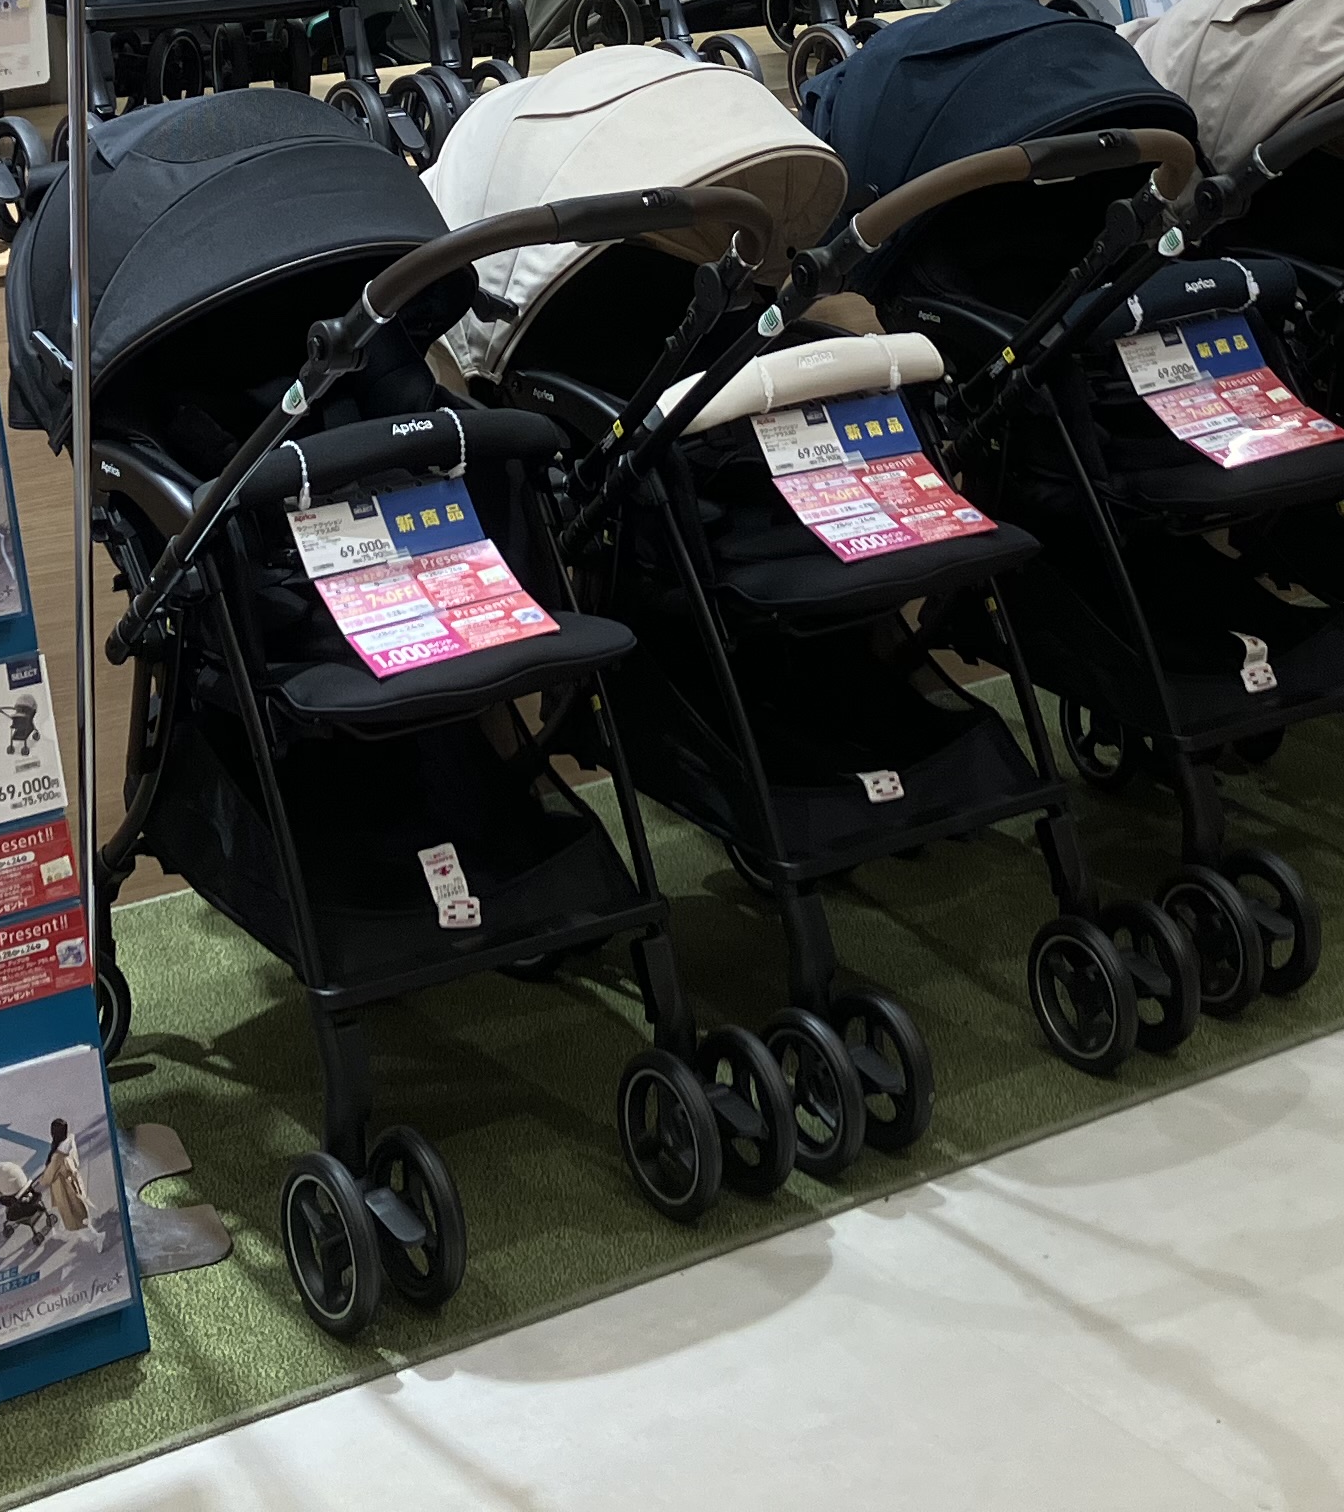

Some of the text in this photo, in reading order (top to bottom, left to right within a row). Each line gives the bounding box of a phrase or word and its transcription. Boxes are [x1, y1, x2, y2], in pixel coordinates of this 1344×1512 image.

[1185, 277, 1216, 293] Aprica
[917, 310, 942, 324] Aprica
[532, 387, 555, 402] Aprica
[391, 418, 434, 436] Aprica
[101, 460, 121, 477] Aprica
[293, 512, 317, 523] Aprica
[372, 644, 431, 670] 1,000
[11, 667, 38, 682] SELECT
[37, 1288, 89, 1318] Cushion
